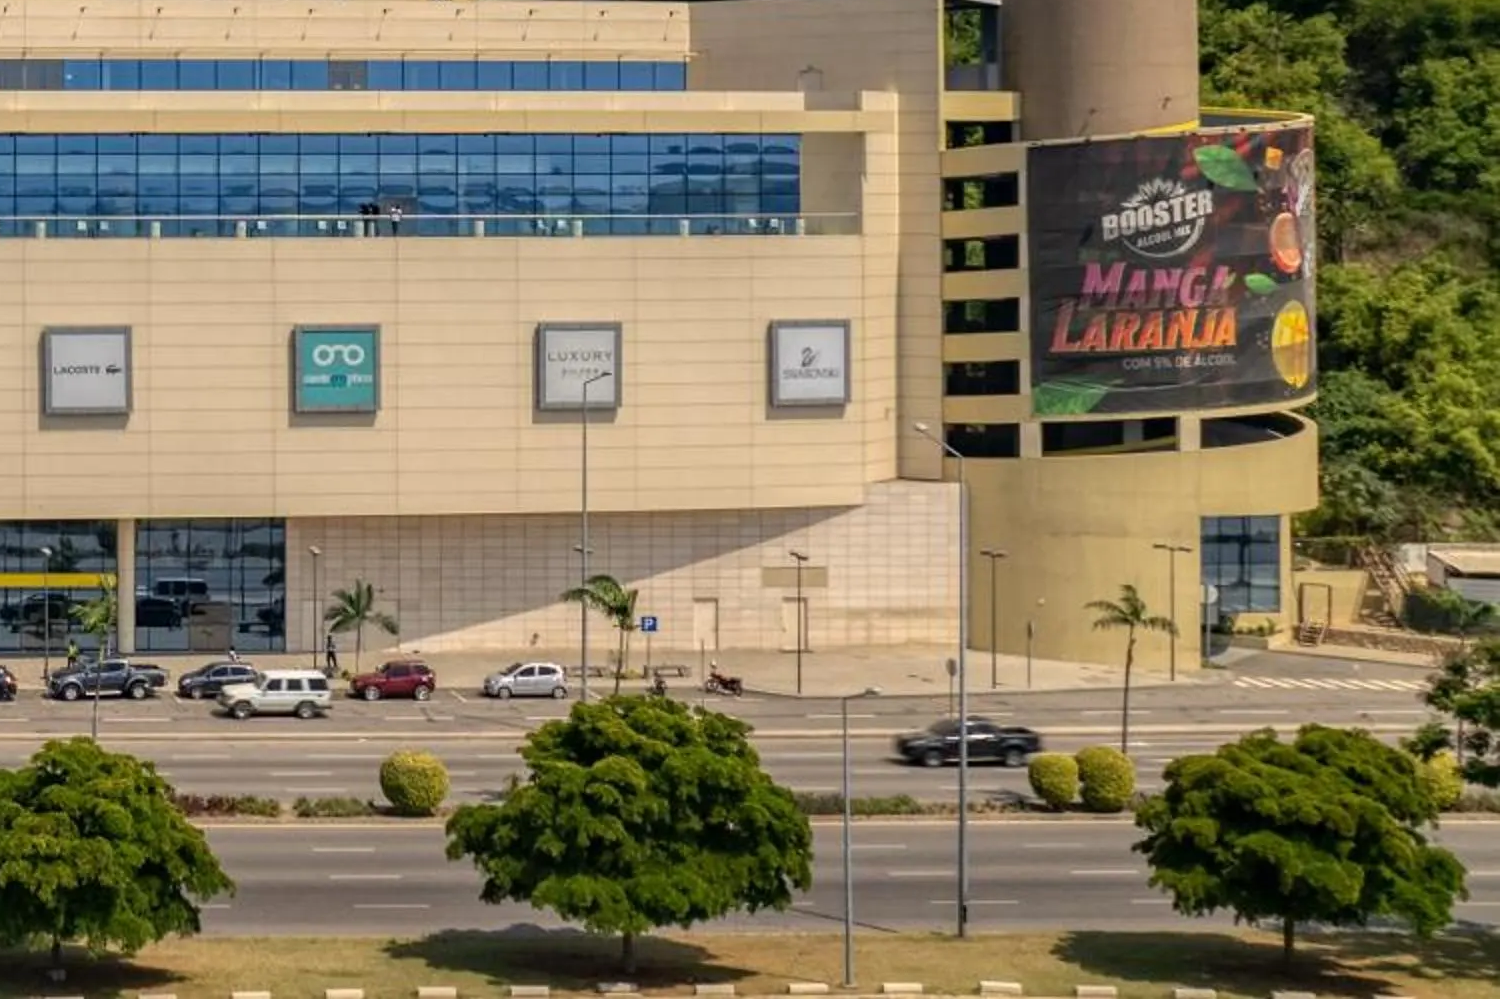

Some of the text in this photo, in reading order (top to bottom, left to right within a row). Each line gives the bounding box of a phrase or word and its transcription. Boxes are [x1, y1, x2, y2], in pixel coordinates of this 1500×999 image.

[1101, 189, 1213, 242] BOOSTER
[1078, 261, 1235, 309] MANGA
[1049, 298, 1238, 353] LARANJA
[547, 350, 612, 362] LUXURY
[643, 618, 654, 629] P
